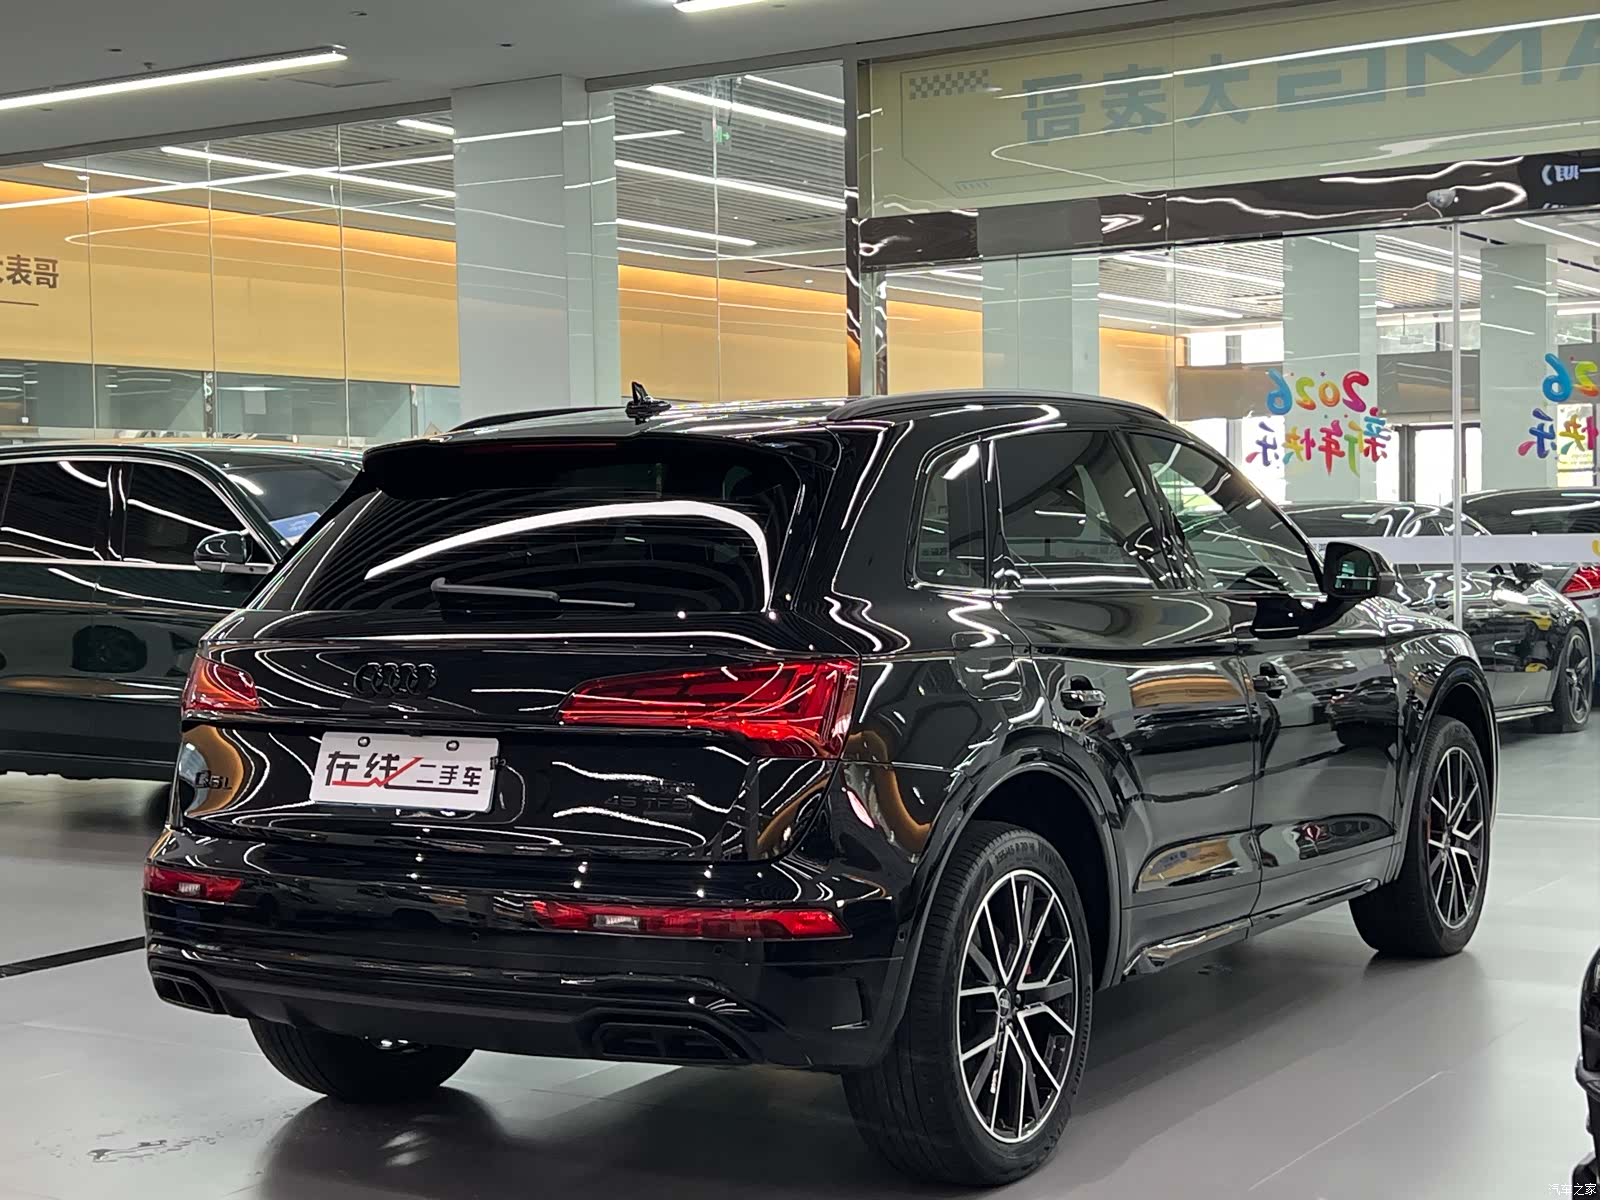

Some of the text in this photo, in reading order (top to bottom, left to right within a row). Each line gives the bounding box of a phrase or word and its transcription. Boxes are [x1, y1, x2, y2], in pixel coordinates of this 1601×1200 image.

[0, 254, 59, 289] 表哥
[195, 769, 232, 791] Q5L
[325, 751, 482, 788] 在线 二手车
[603, 794, 693, 810] 45 TFSI
